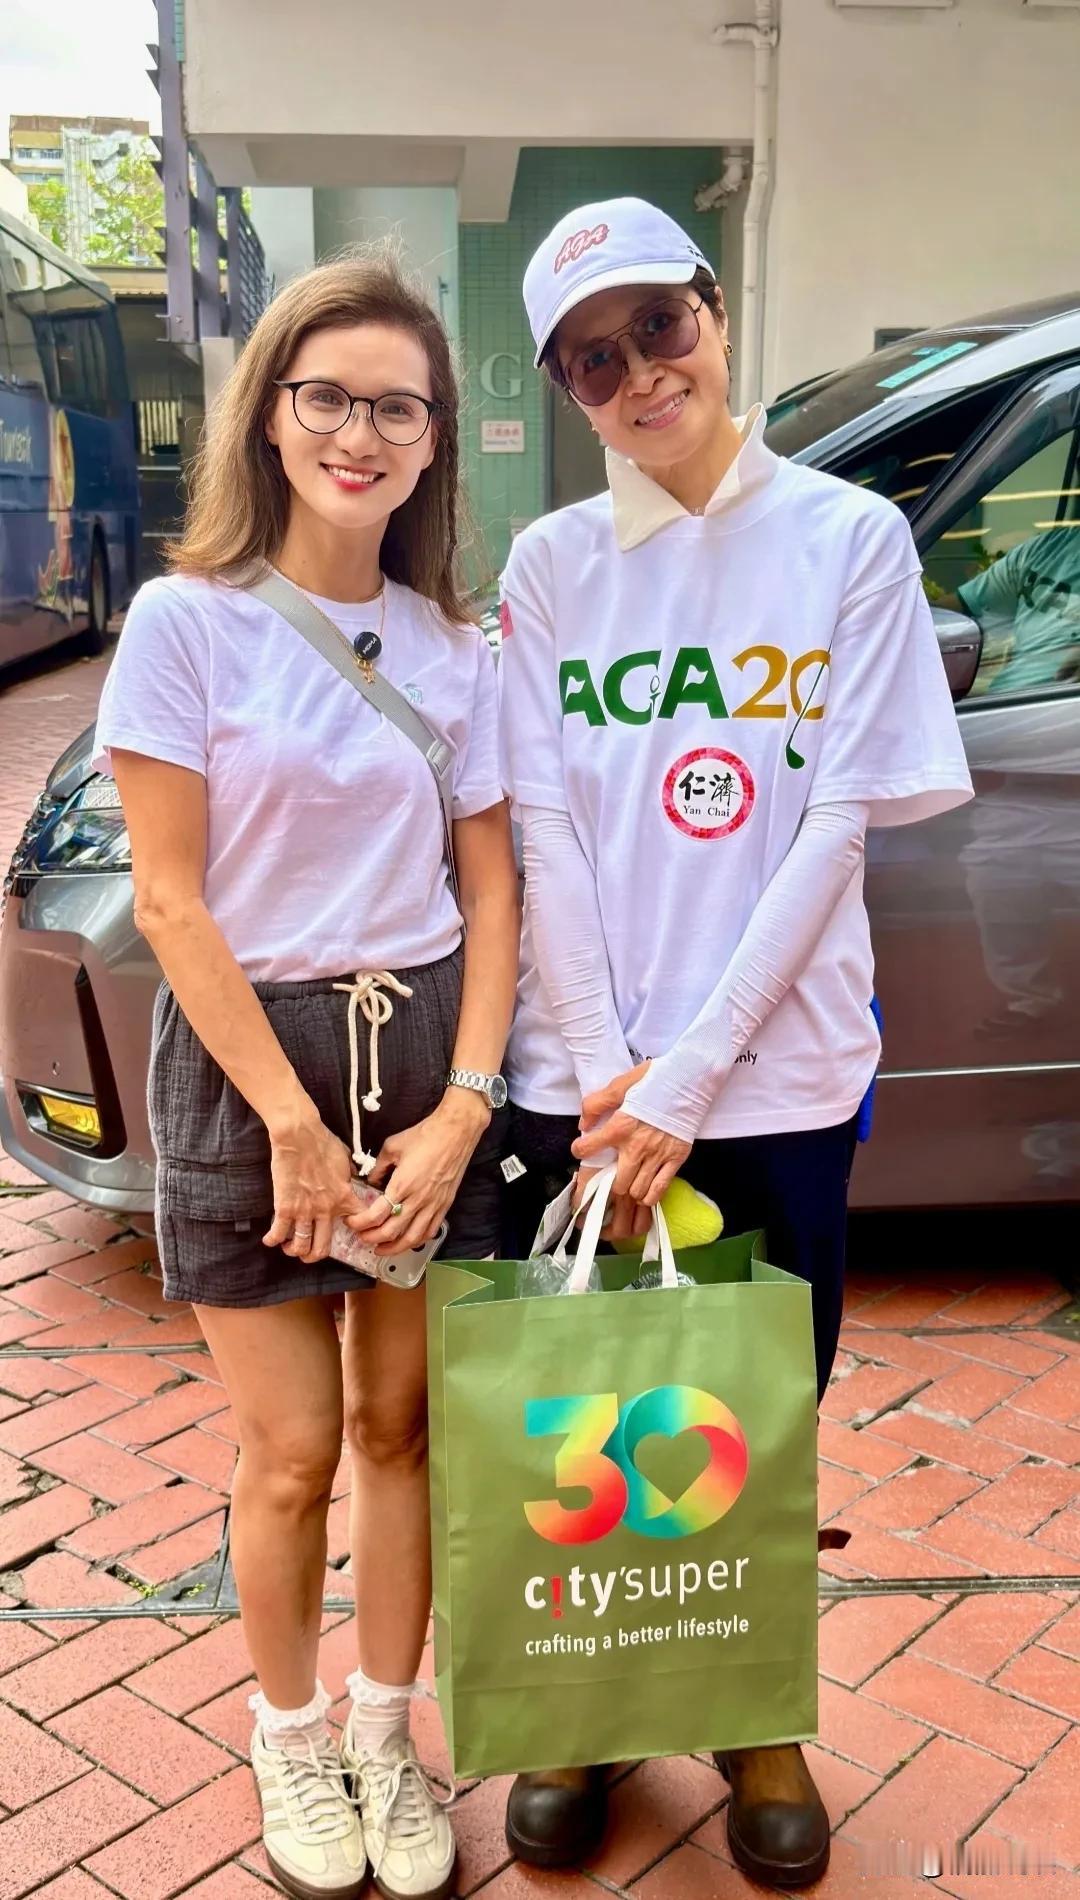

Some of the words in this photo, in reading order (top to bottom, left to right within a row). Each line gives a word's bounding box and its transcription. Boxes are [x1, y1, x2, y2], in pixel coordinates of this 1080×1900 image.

[554, 223, 610, 274] AGA
[480, 352, 522, 399] G
[684, 804, 701, 816] Yan
[707, 806, 730, 818] Chai
[522, 1384, 749, 1546] 30
[525, 1633, 596, 1657] crafting
[602, 1634, 612, 1650] a
[618, 1624, 672, 1648] better
[677, 1614, 749, 1639] lifestyle
